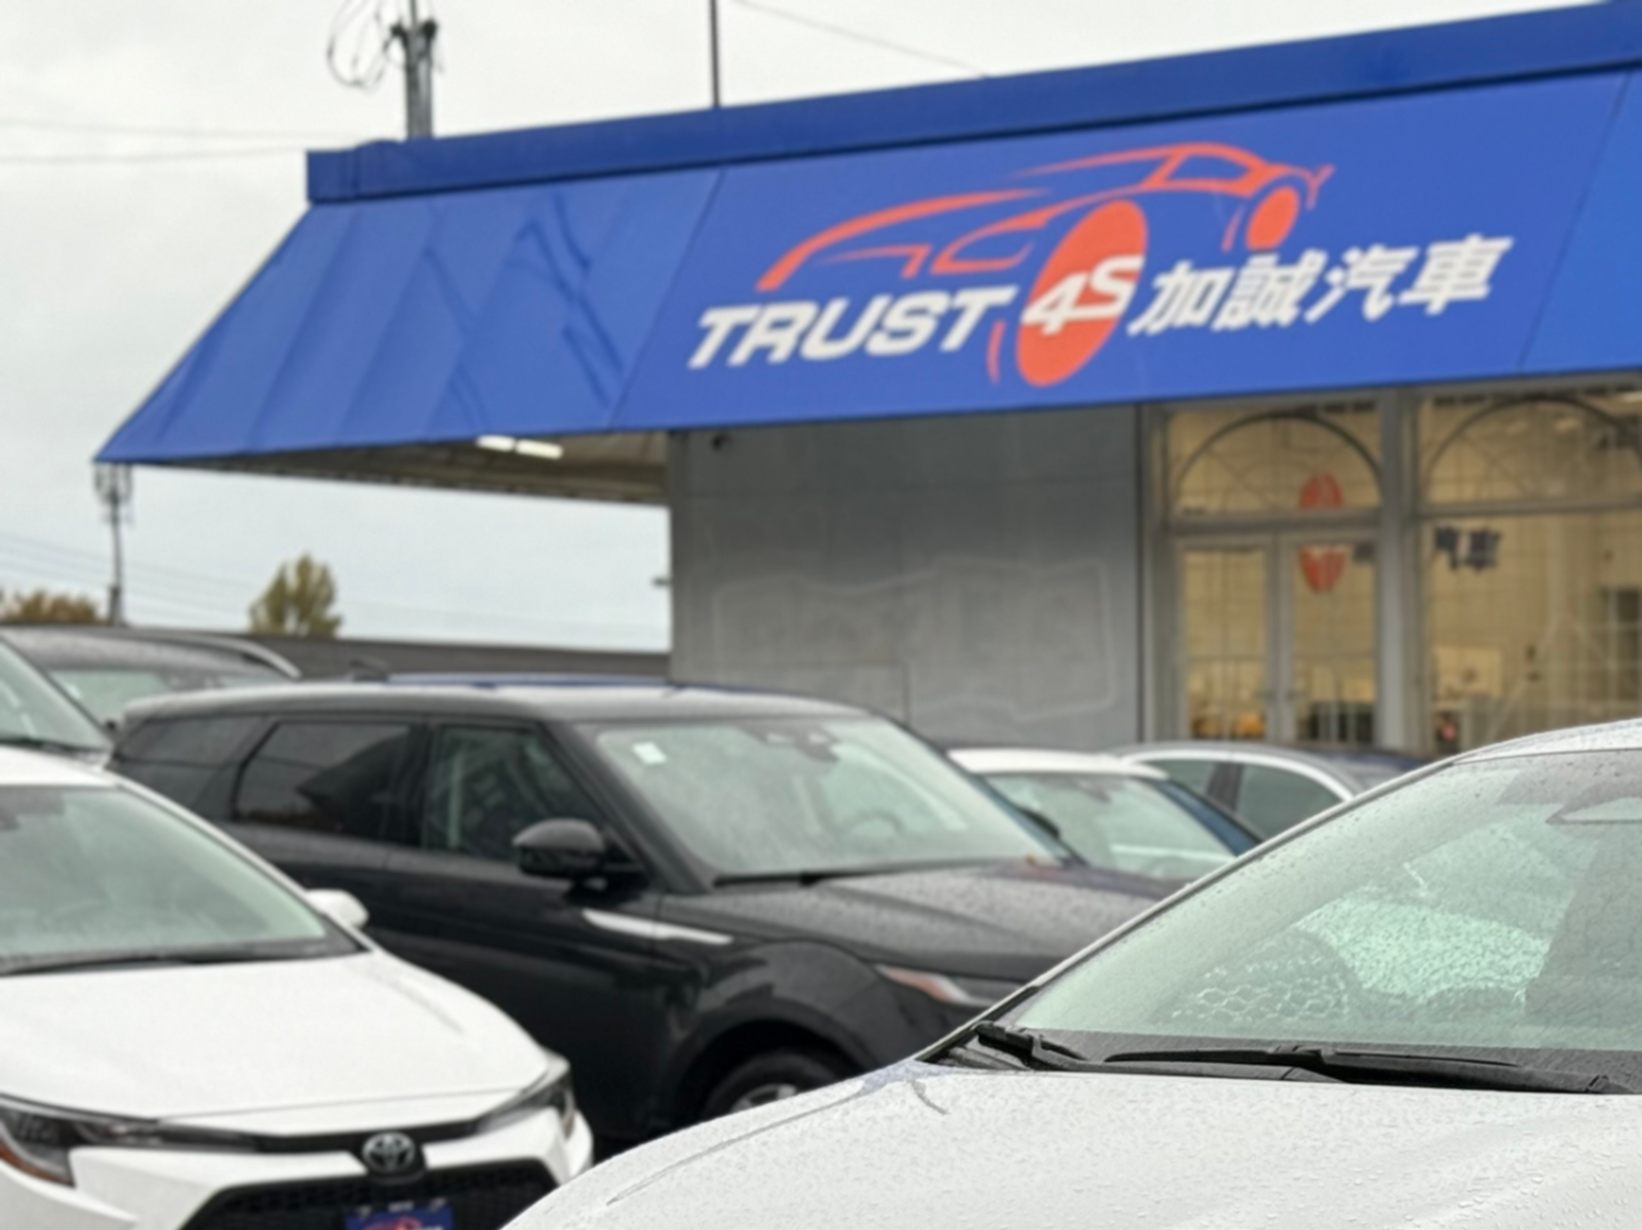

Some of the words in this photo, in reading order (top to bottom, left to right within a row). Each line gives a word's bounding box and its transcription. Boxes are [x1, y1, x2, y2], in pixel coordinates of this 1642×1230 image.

[688, 285, 1017, 370] TRUST
[1021, 256, 1144, 337] 4S
[1127, 234, 1514, 337] 加誠汽車
